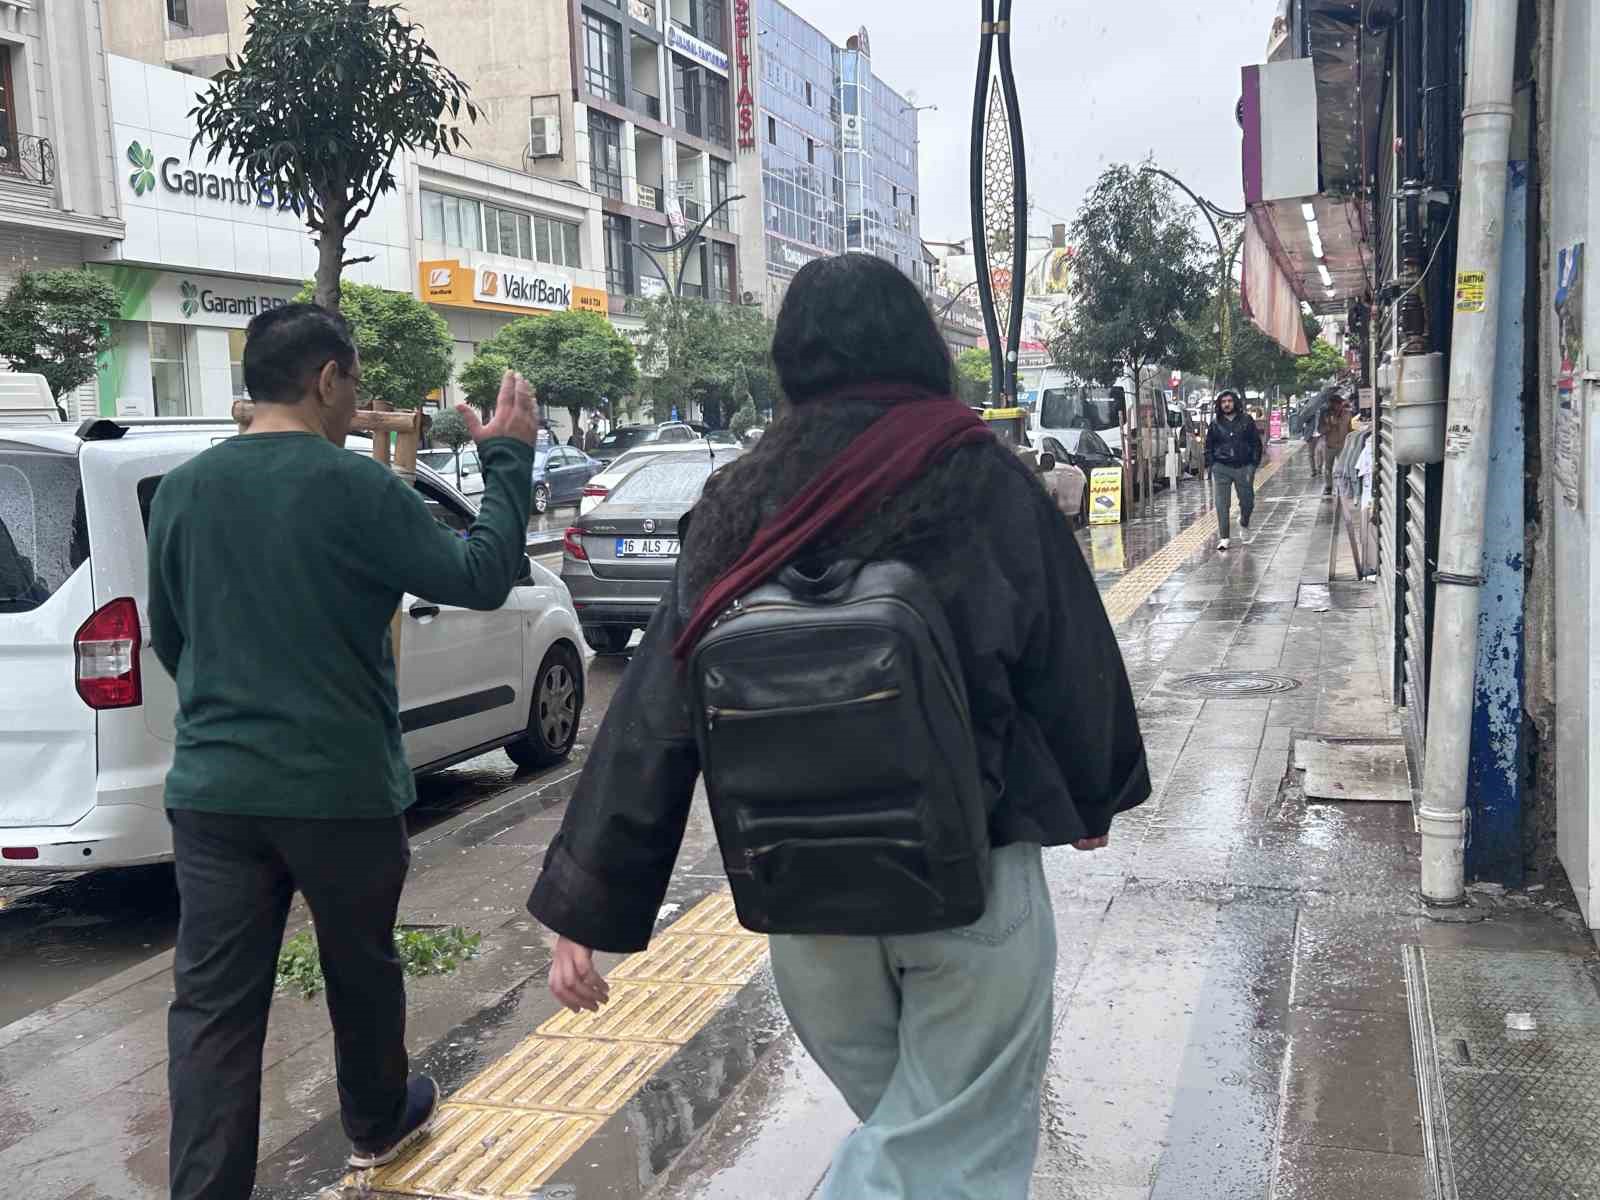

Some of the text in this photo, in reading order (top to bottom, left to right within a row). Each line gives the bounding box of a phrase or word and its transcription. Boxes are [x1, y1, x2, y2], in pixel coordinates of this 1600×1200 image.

[160, 156, 251, 206] Garanti
[201, 289, 257, 316] Garanti
[503, 273, 571, 307] VakıfBank
[624, 540, 634, 553] 16
[642, 540, 661, 553] ALS
